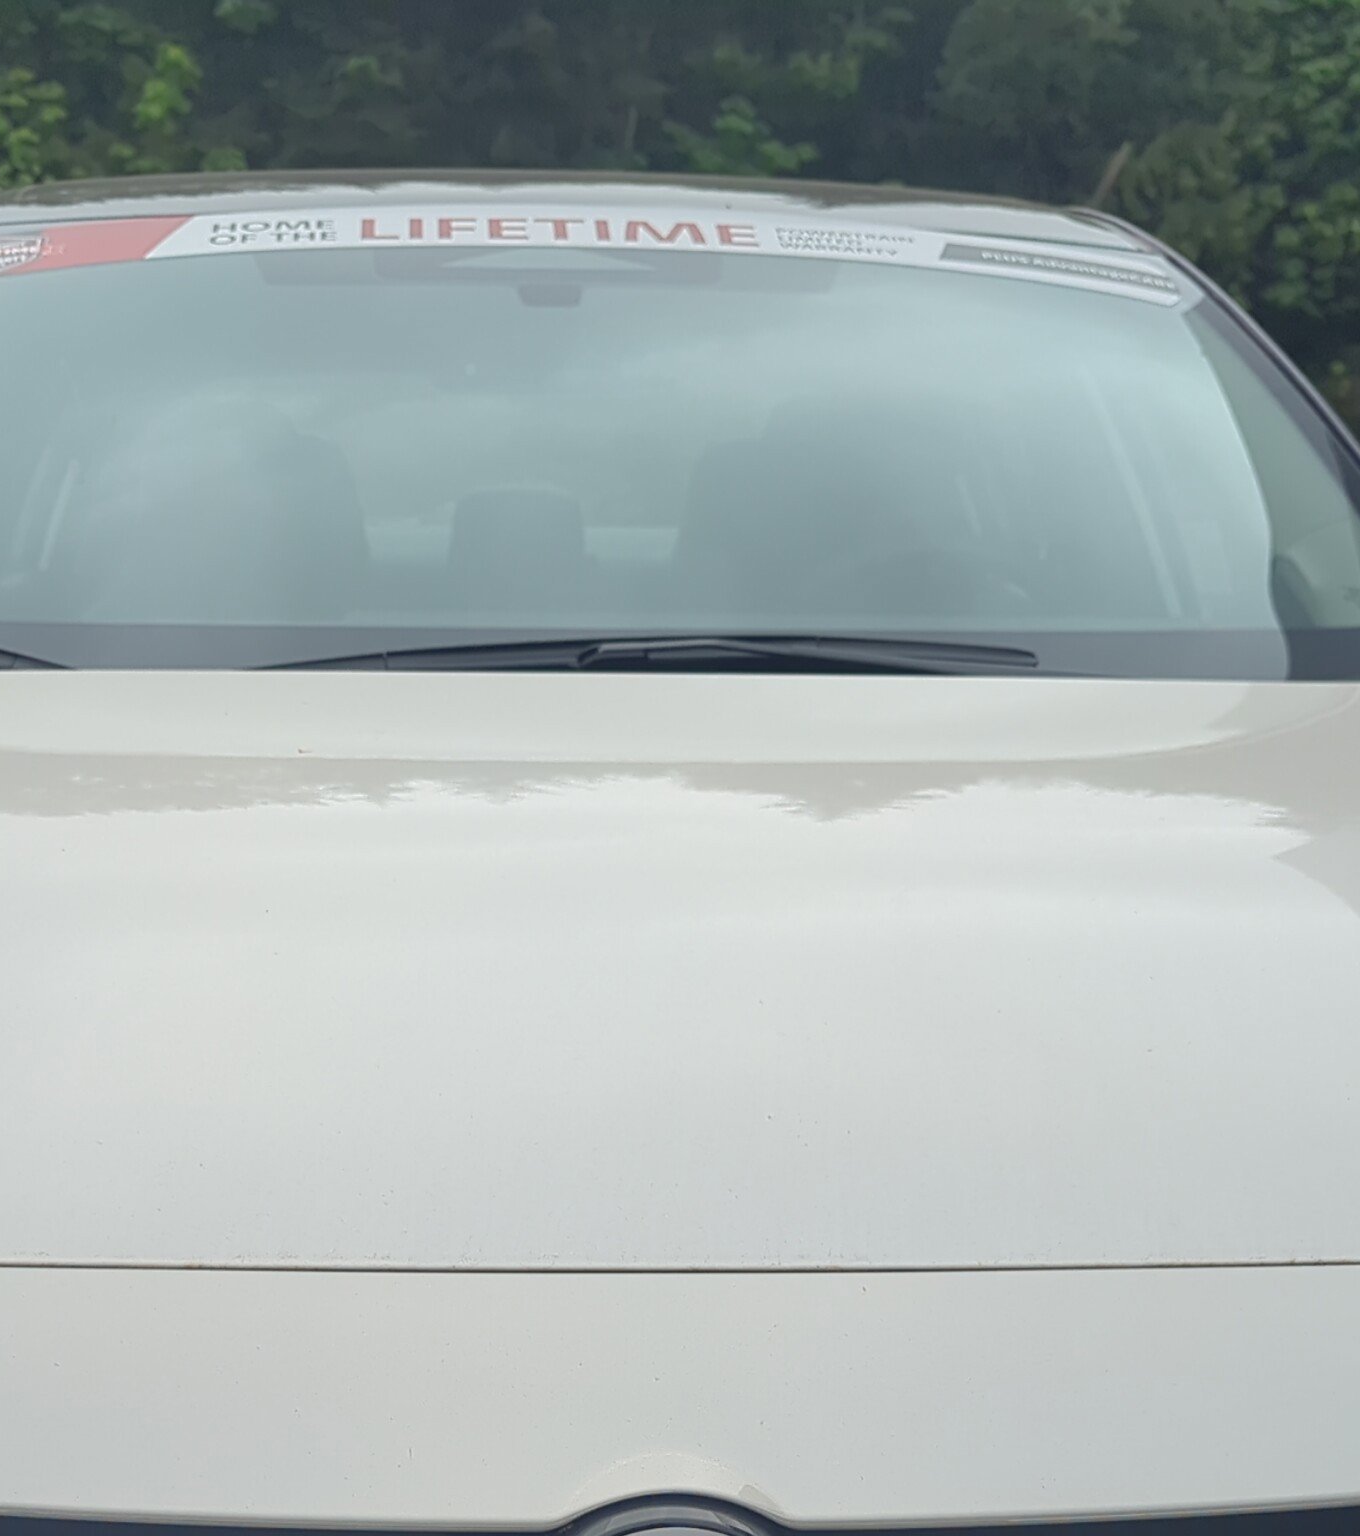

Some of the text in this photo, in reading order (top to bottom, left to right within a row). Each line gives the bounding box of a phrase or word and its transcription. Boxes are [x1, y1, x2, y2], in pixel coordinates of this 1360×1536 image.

[213, 220, 335, 233] HOME
[360, 217, 760, 247] LIFETIME
[209, 231, 337, 245] OF THE
